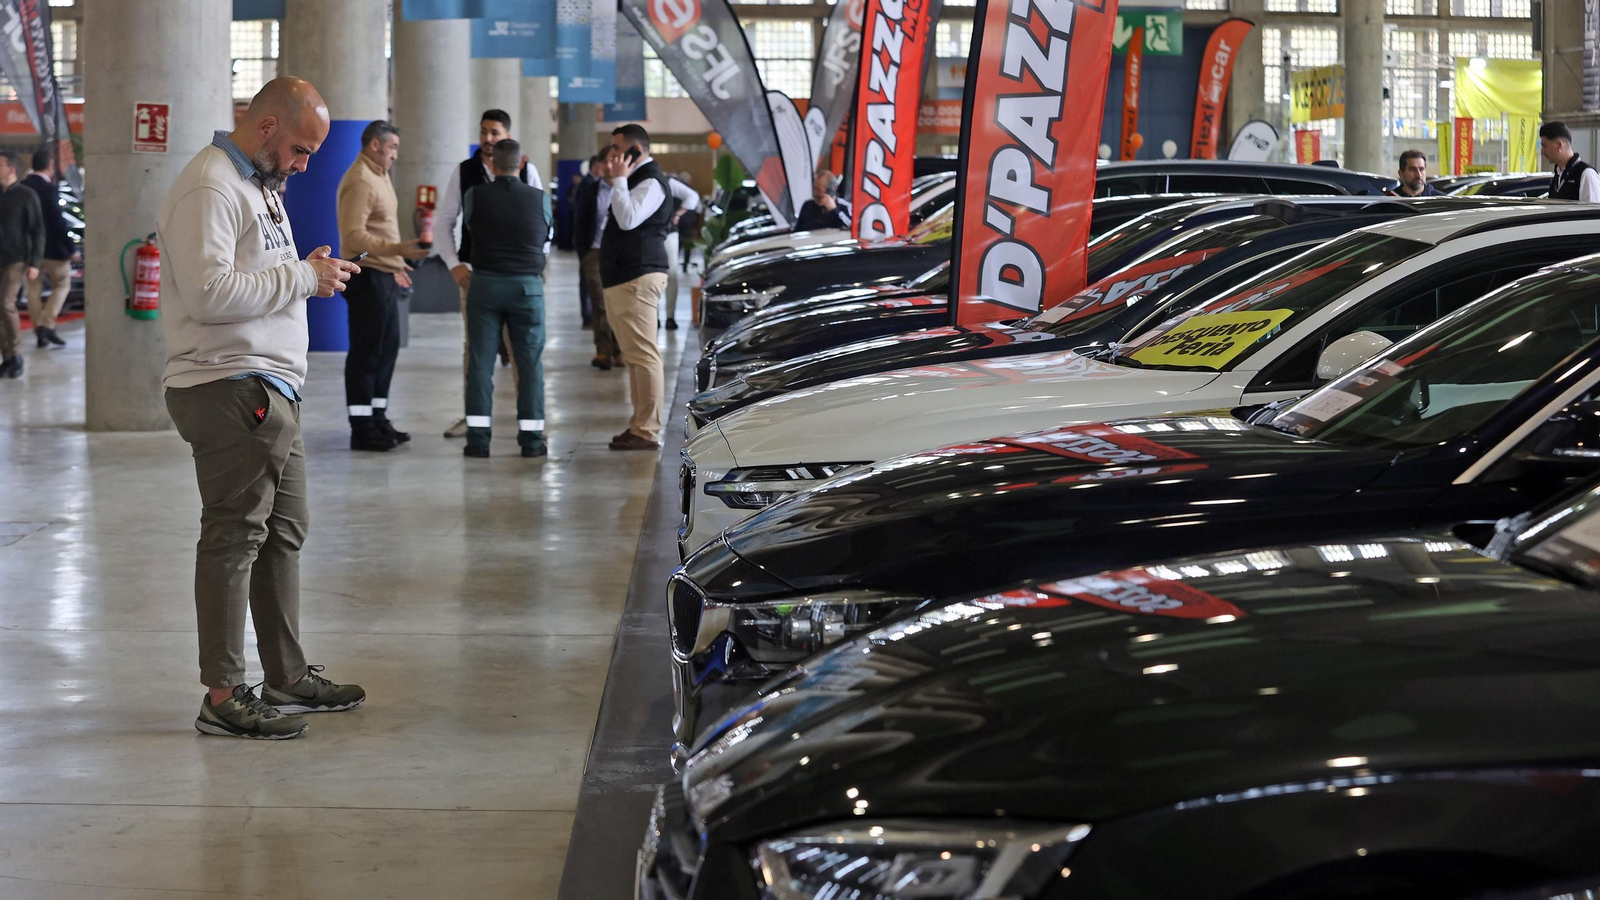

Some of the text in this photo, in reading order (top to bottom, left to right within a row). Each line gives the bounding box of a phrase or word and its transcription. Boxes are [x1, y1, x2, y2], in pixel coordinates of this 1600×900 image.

[823, 29, 862, 86] JFS
[1148, 318, 1271, 348] DESCUENTO
[1163, 336, 1235, 357] Feria
